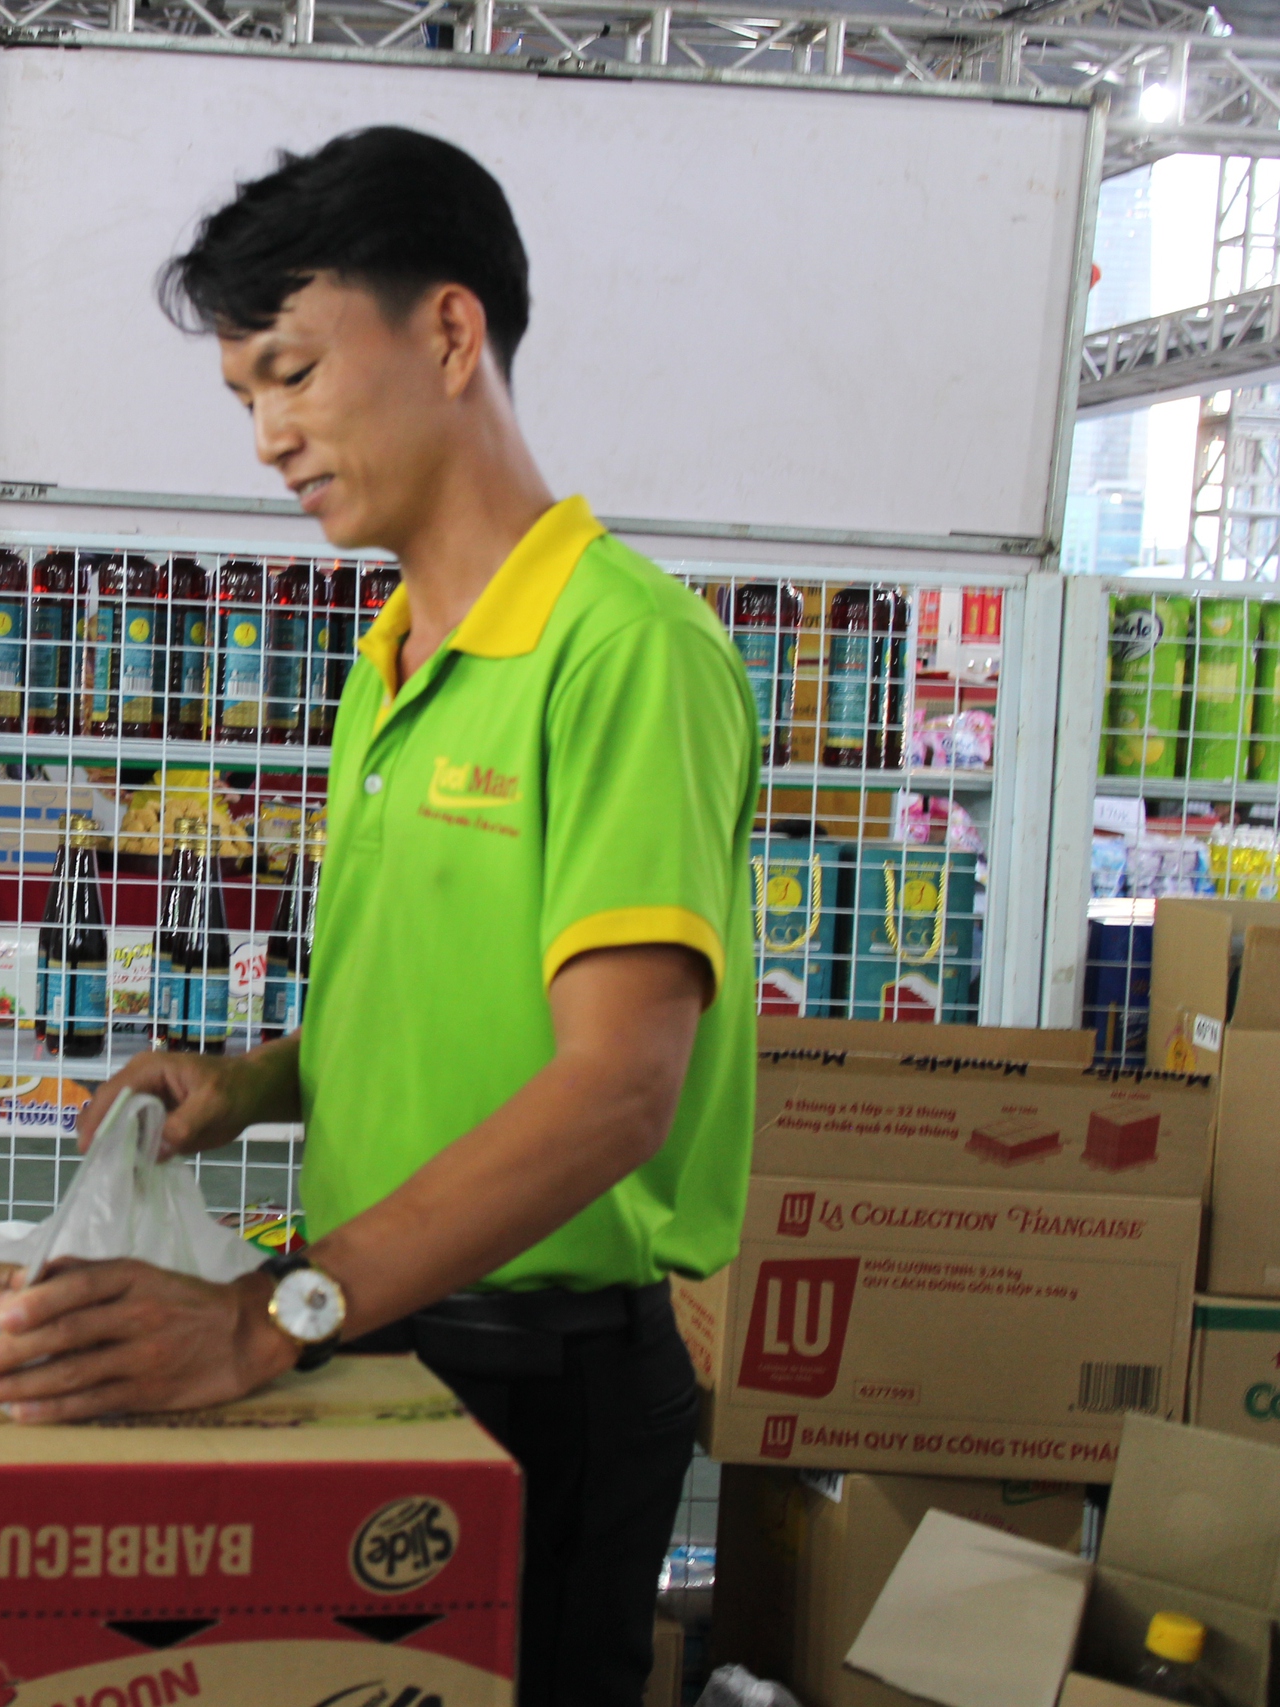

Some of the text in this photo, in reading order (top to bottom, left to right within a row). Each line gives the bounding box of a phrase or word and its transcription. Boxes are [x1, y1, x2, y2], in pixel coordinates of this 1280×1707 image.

[818, 1200, 846, 1232] LA
[851, 1202, 998, 1232] COLLECTION
[762, 1277, 835, 1358] LU
[801, 1423, 859, 1449] BÁNH
[863, 1430, 908, 1452] QUY
[946, 1432, 1005, 1457] CÔNG
[366, 1506, 453, 1579] Slide
